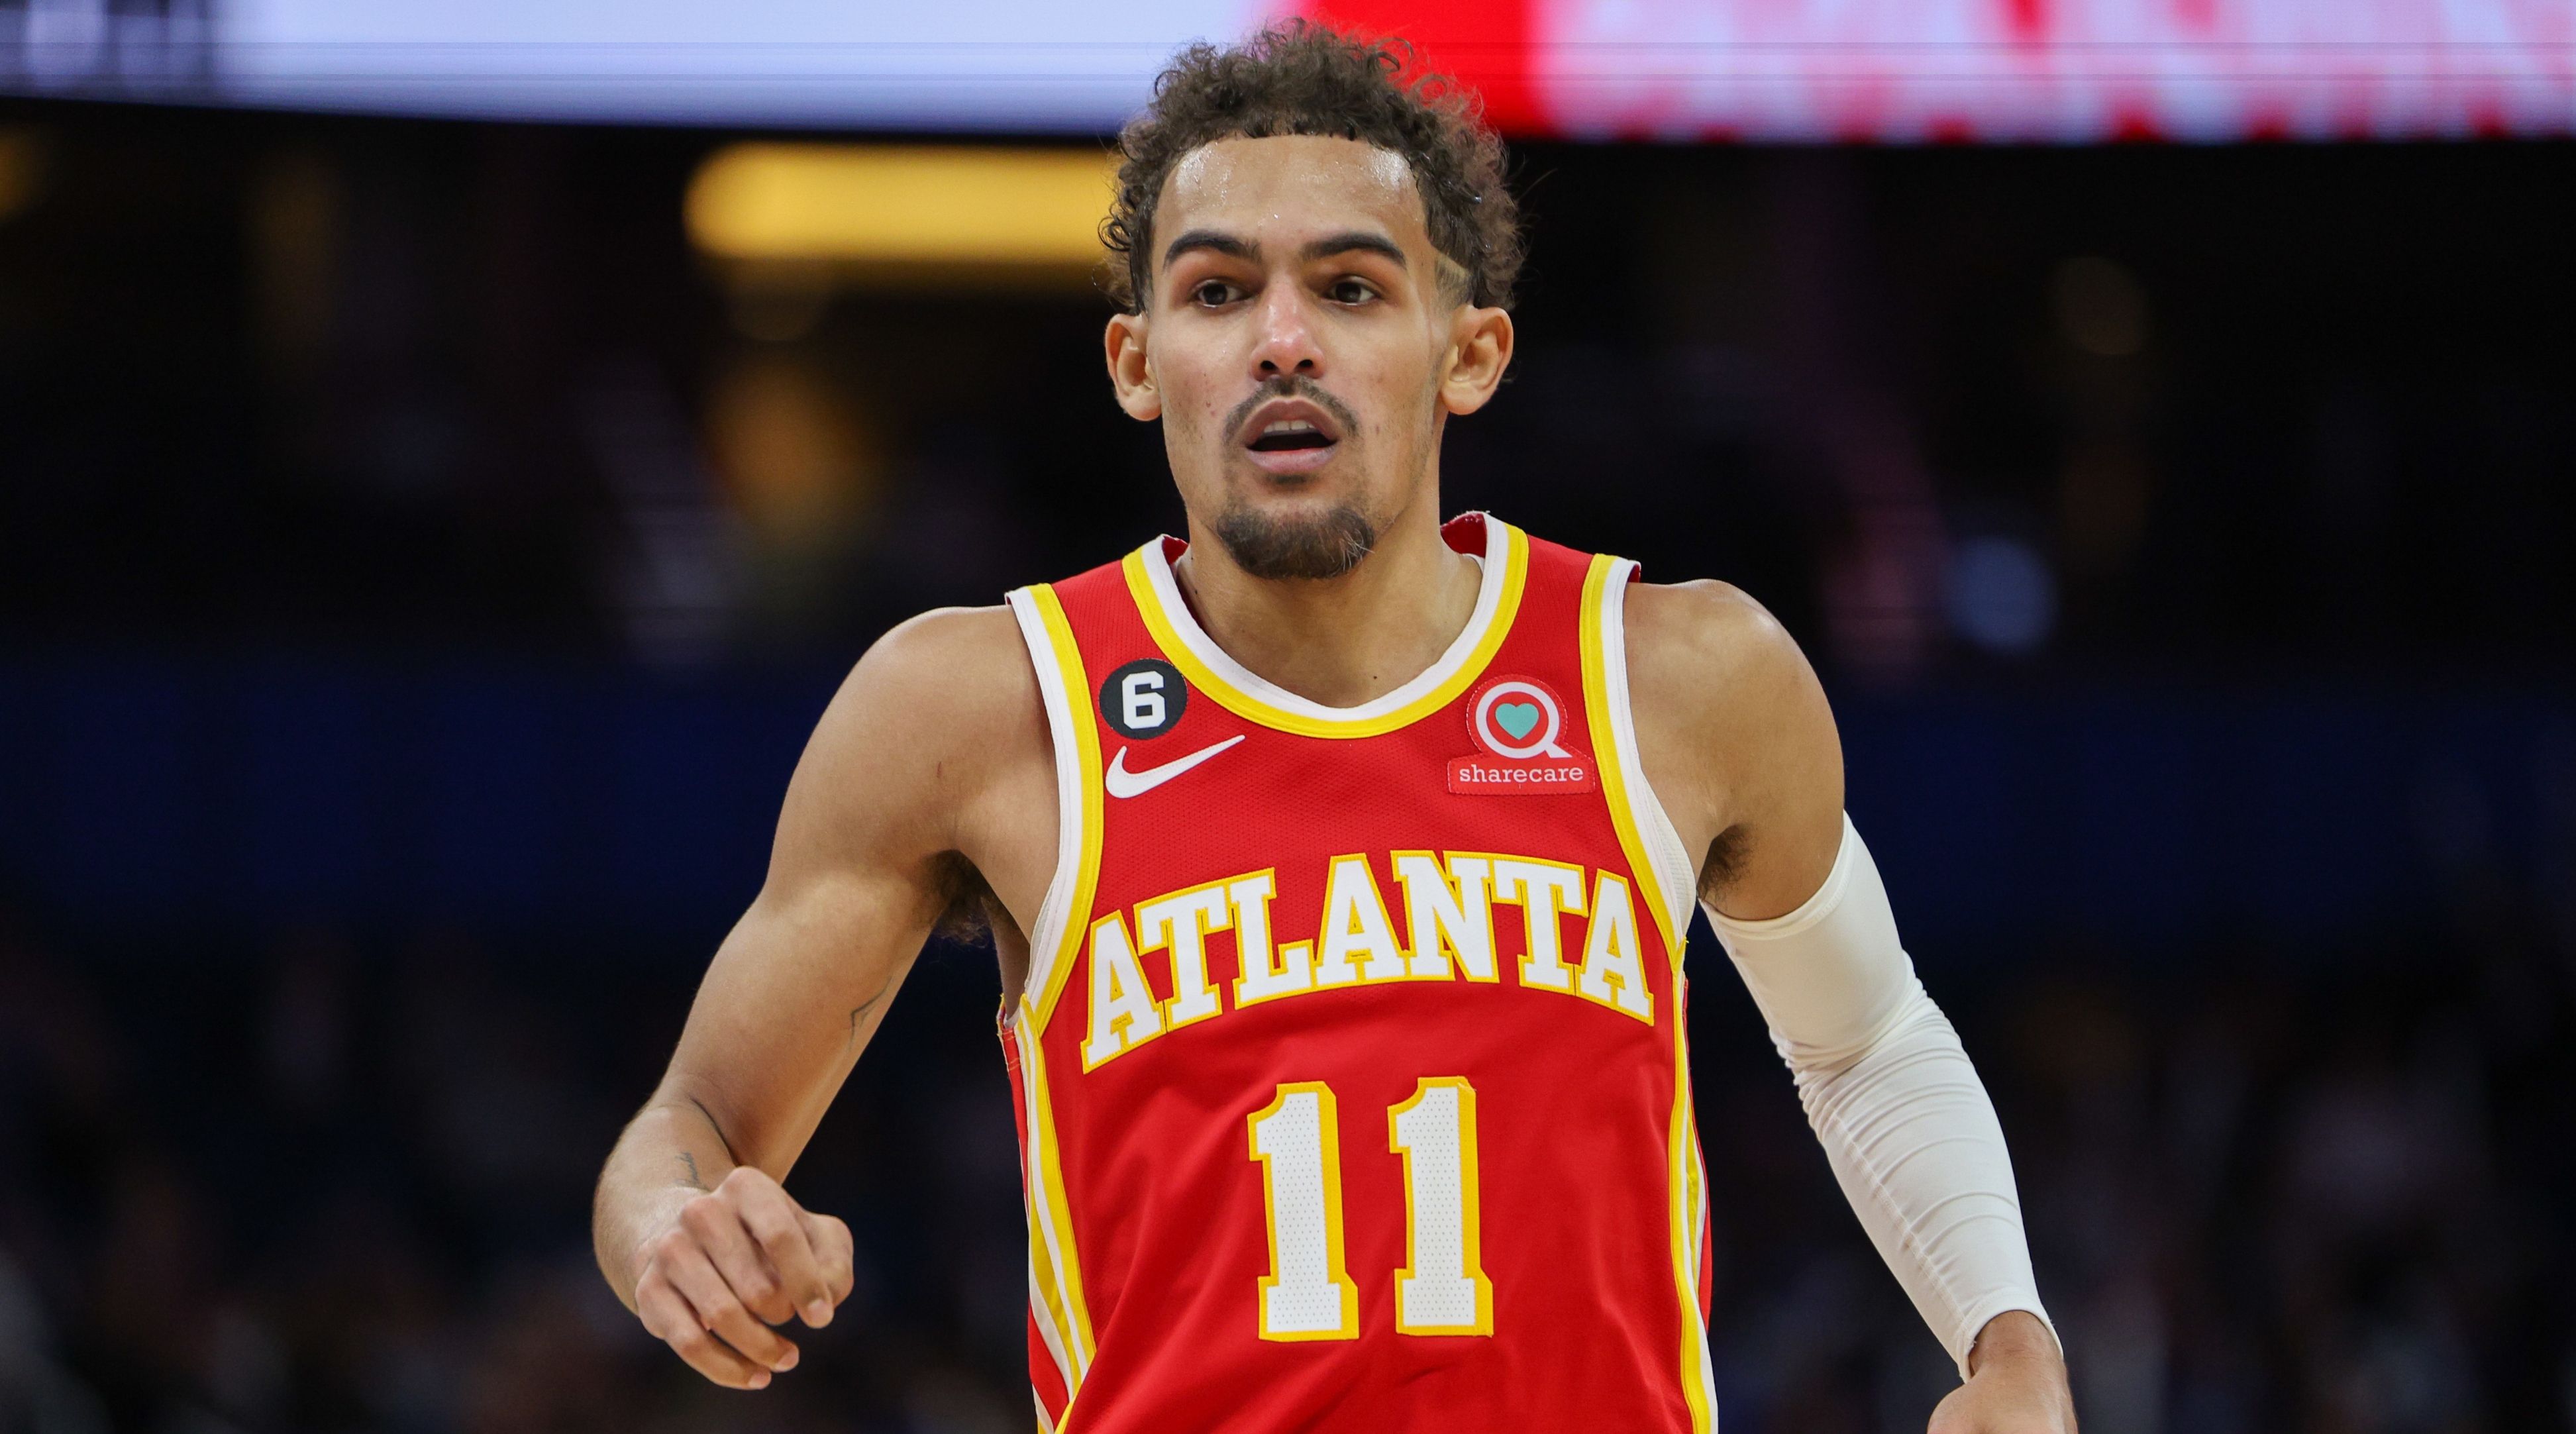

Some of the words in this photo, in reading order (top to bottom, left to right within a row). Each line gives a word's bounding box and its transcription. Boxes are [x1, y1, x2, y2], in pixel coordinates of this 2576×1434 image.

[1121, 671, 1166, 729] 6
[1459, 764, 1584, 783] sharecare
[1080, 850, 1654, 1074] ATLANTA
[1247, 1076, 1494, 1342] 11
